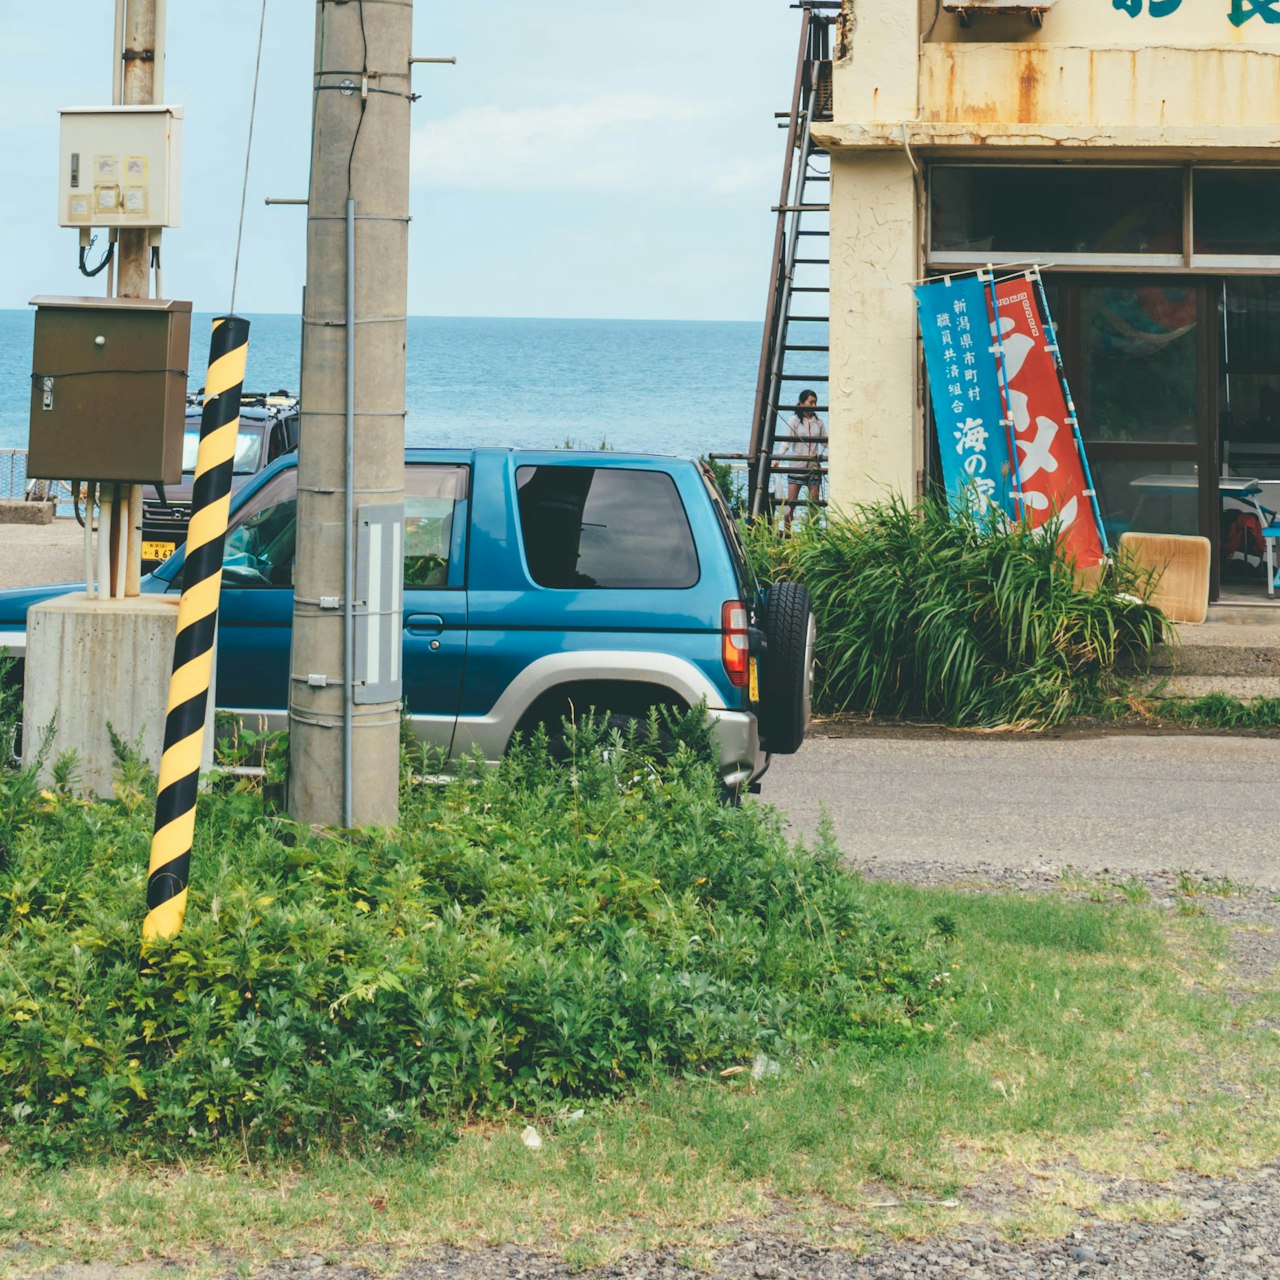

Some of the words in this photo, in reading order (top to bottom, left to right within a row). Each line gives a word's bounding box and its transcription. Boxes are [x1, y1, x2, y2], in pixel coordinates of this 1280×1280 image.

[936, 313, 965, 414] 職員共済組合
[953, 299, 981, 402] 新潟県市町村
[990, 317, 1078, 542] ラーメン
